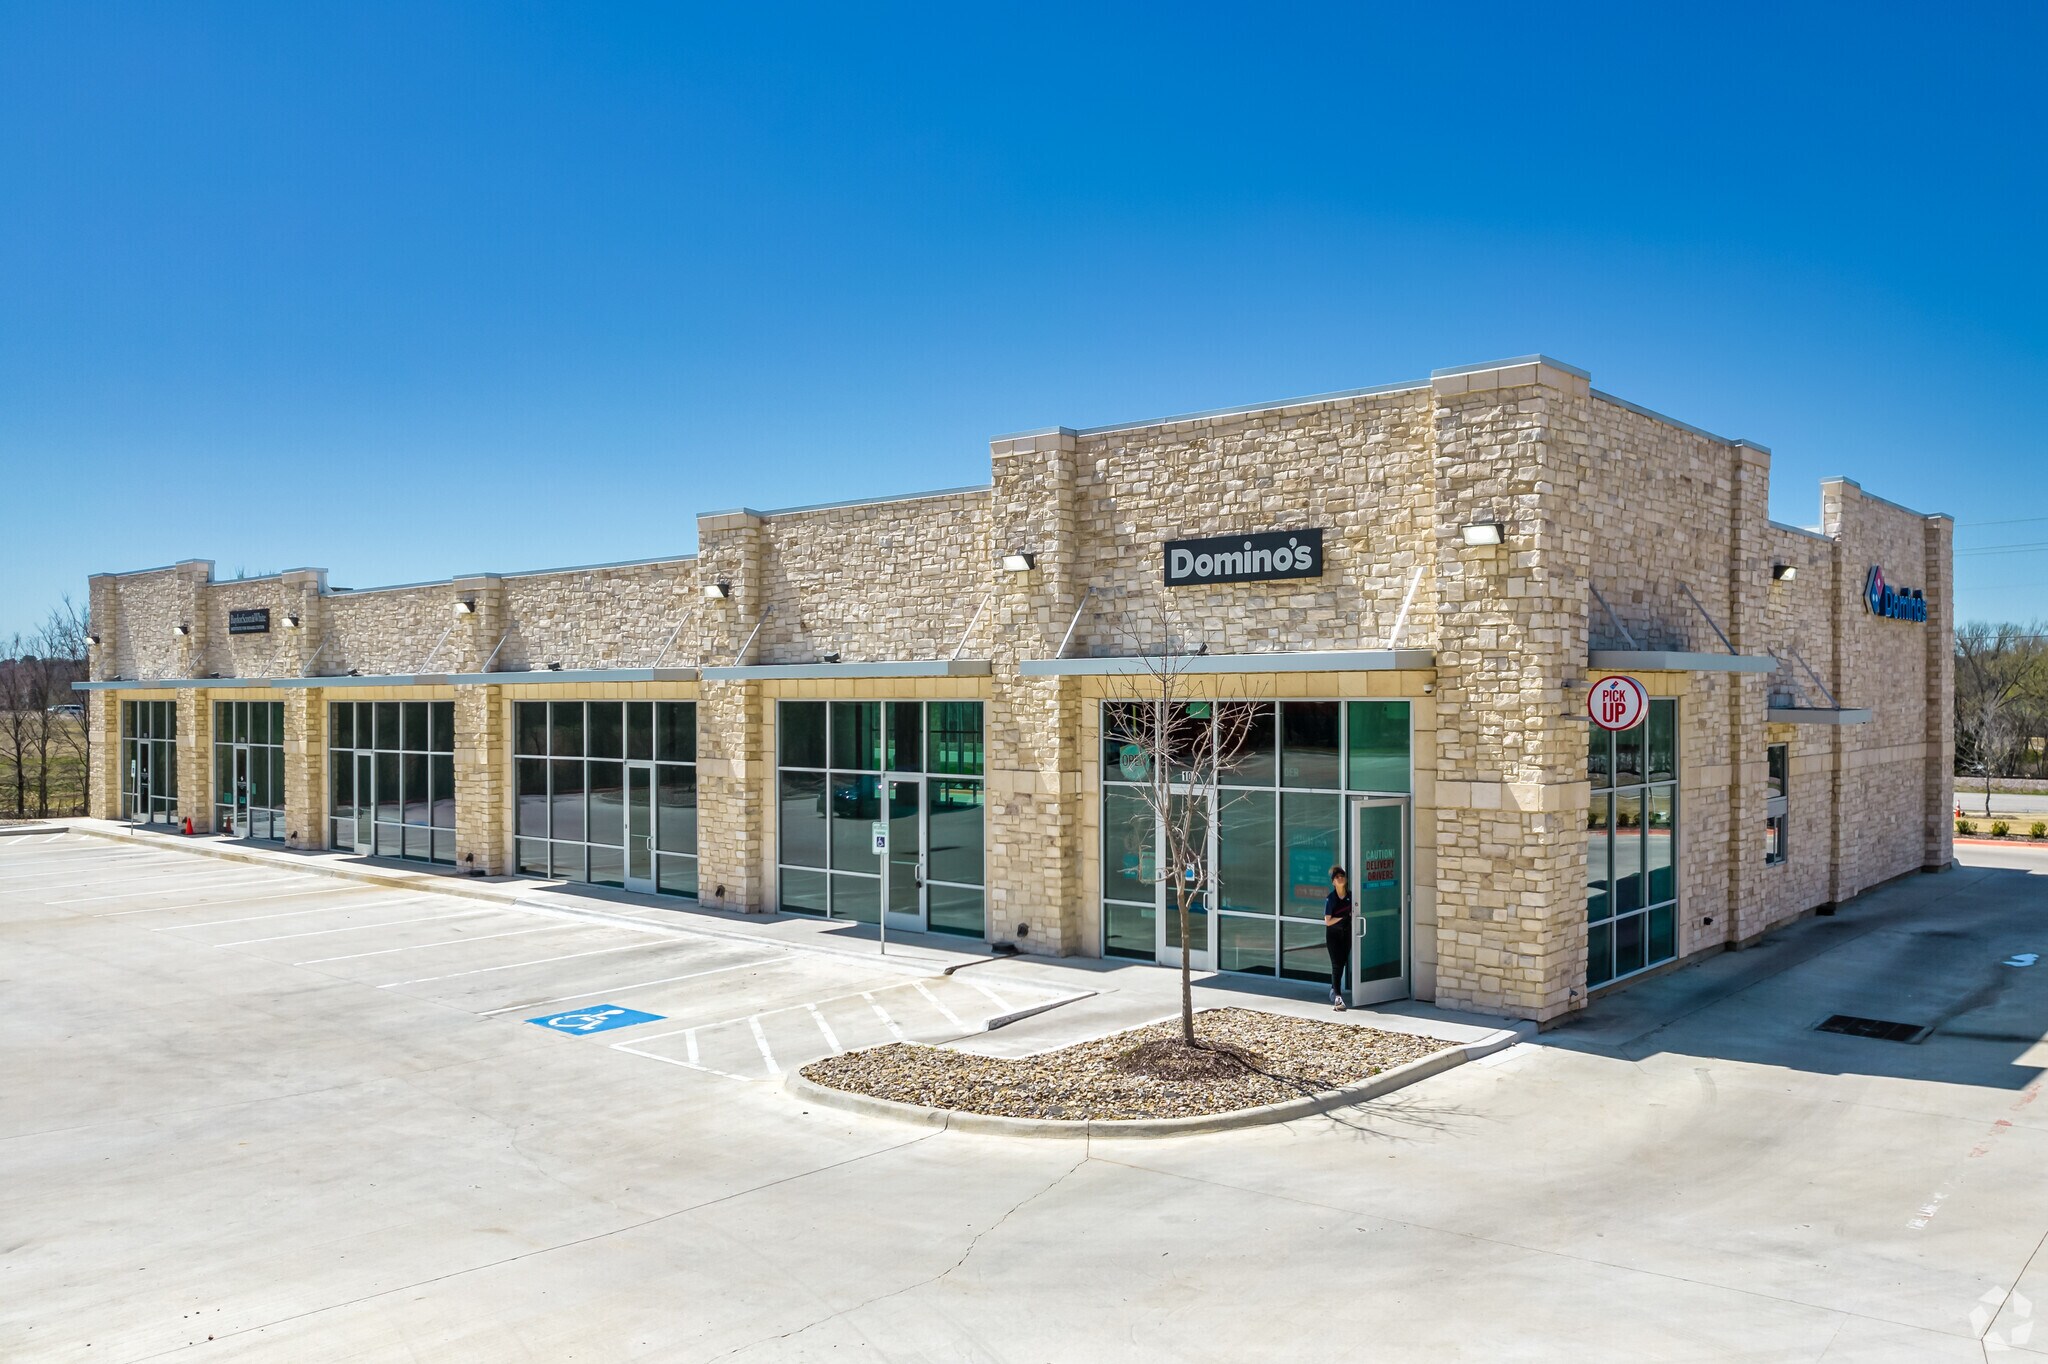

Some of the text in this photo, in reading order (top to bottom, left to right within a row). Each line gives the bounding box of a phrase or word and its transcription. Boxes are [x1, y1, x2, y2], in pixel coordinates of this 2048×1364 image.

[1171, 537, 1313, 579] Domino's
[1602, 690, 1626, 702] PICK
[1602, 702, 1626, 723] UP
[1182, 770, 1198, 782] 10
[1365, 849, 1395, 860] CAUTION!
[1366, 859, 1395, 871] DELIVERY
[1367, 870, 1394, 882] DRIVERS
